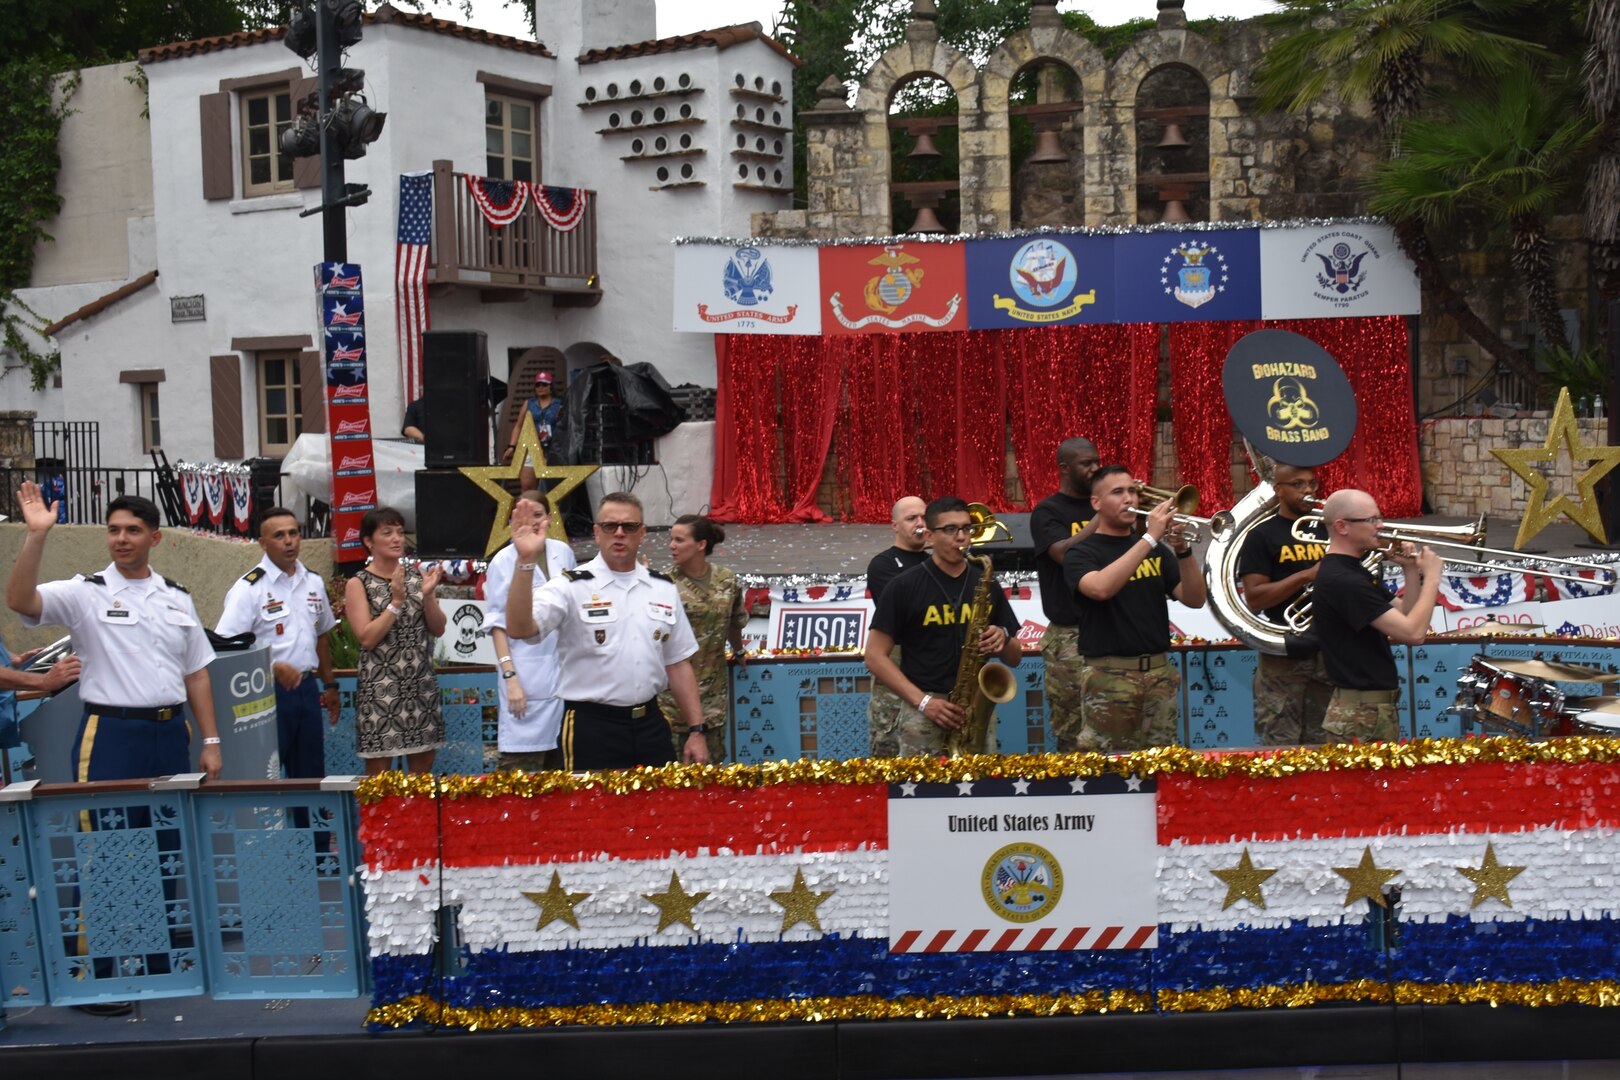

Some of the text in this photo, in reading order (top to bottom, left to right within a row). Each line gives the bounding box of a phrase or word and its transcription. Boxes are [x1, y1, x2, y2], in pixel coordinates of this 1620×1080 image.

[1301, 231, 1380, 263] UNITED STATES COAST GUARD
[1313, 290, 1369, 302] SEMPER PARATUS
[706, 311, 788, 323] UNITED STATES ARMY
[837, 311, 954, 328] UNITED STATES MARINE CORPS
[1011, 306, 1077, 320] UNITED STATES NAVY
[1251, 362, 1317, 380] BIOHAZARD
[1265, 426, 1330, 443] BRASS BAND
[796, 617, 847, 650] USO
[230, 667, 266, 698] GO
[947, 812, 1096, 833] United States Army
[984, 844, 1019, 880] DEPARTMENT
